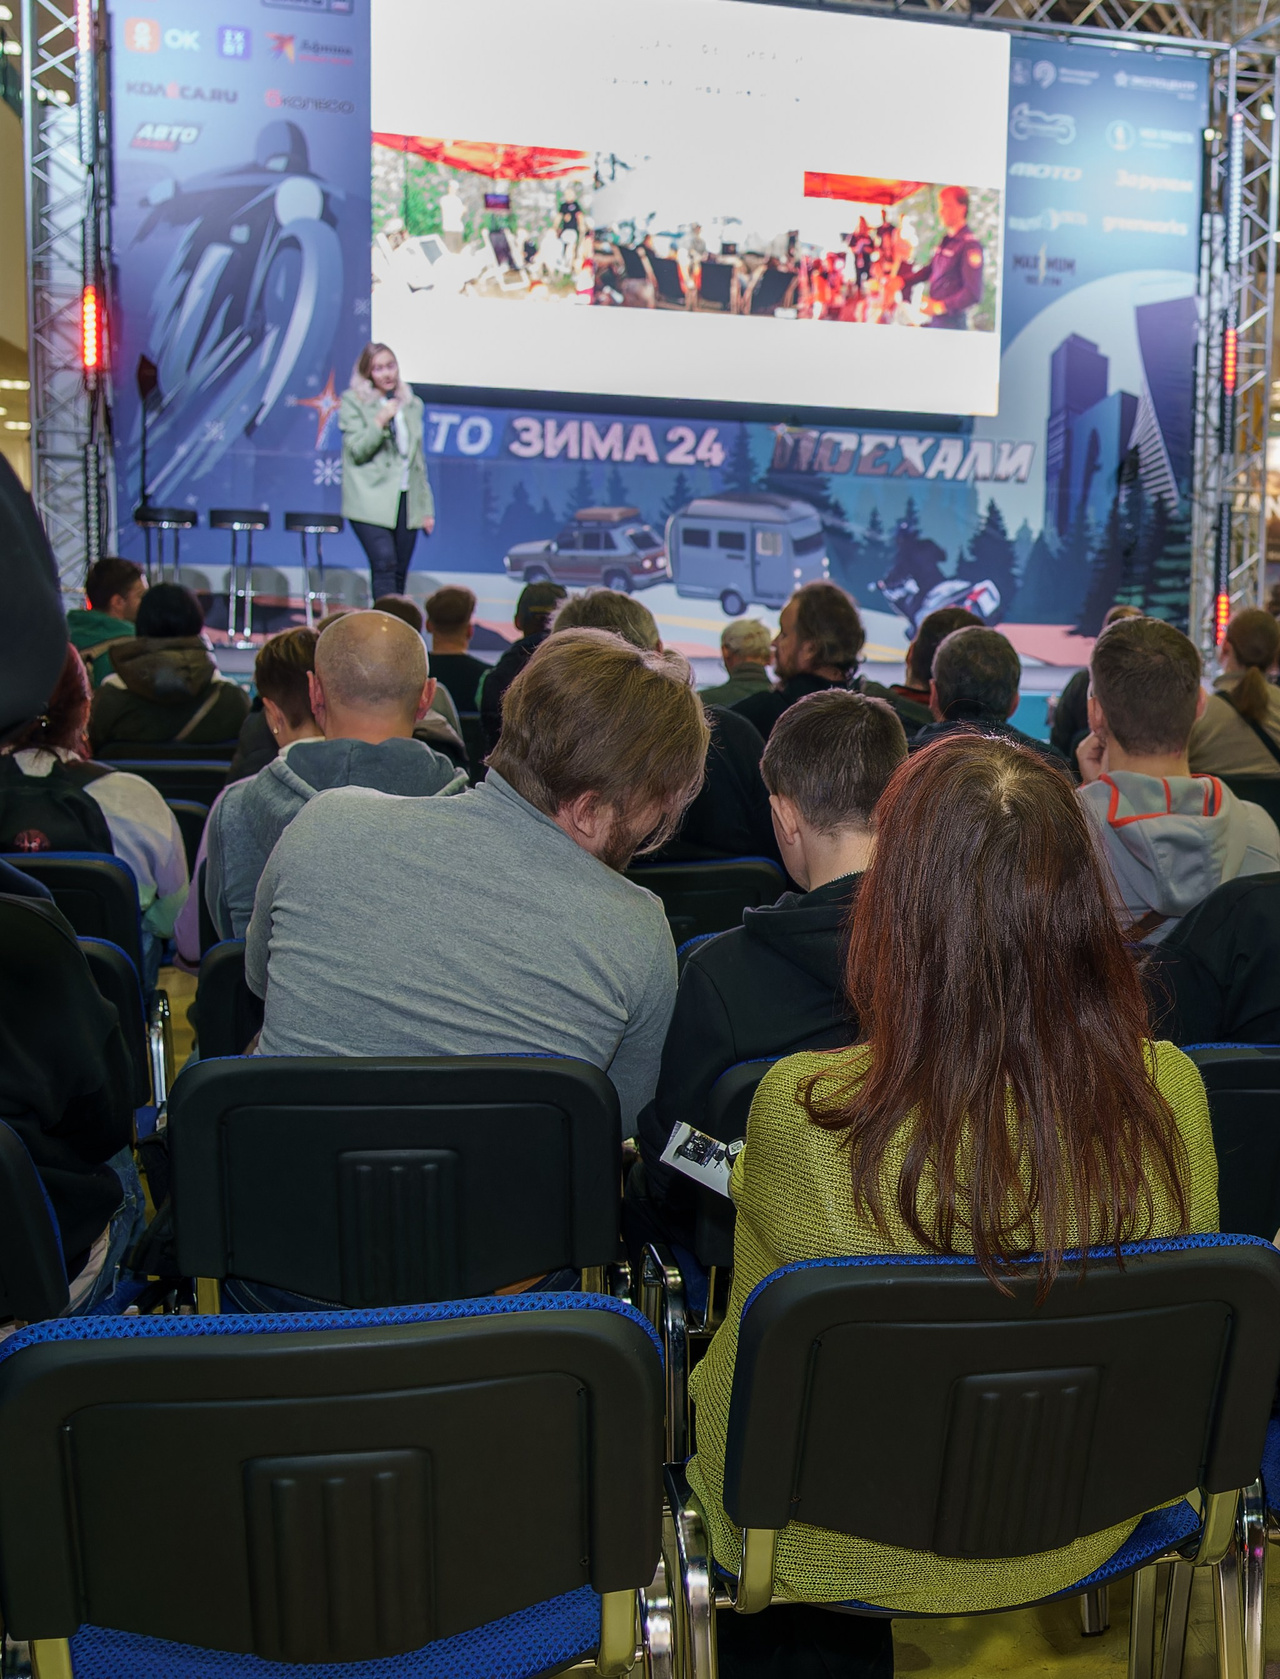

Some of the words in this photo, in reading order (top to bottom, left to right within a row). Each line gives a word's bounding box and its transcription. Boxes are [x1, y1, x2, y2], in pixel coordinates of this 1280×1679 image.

[428, 411, 493, 456] ТО
[509, 416, 660, 463] ЗИМА
[665, 425, 726, 467] 24
